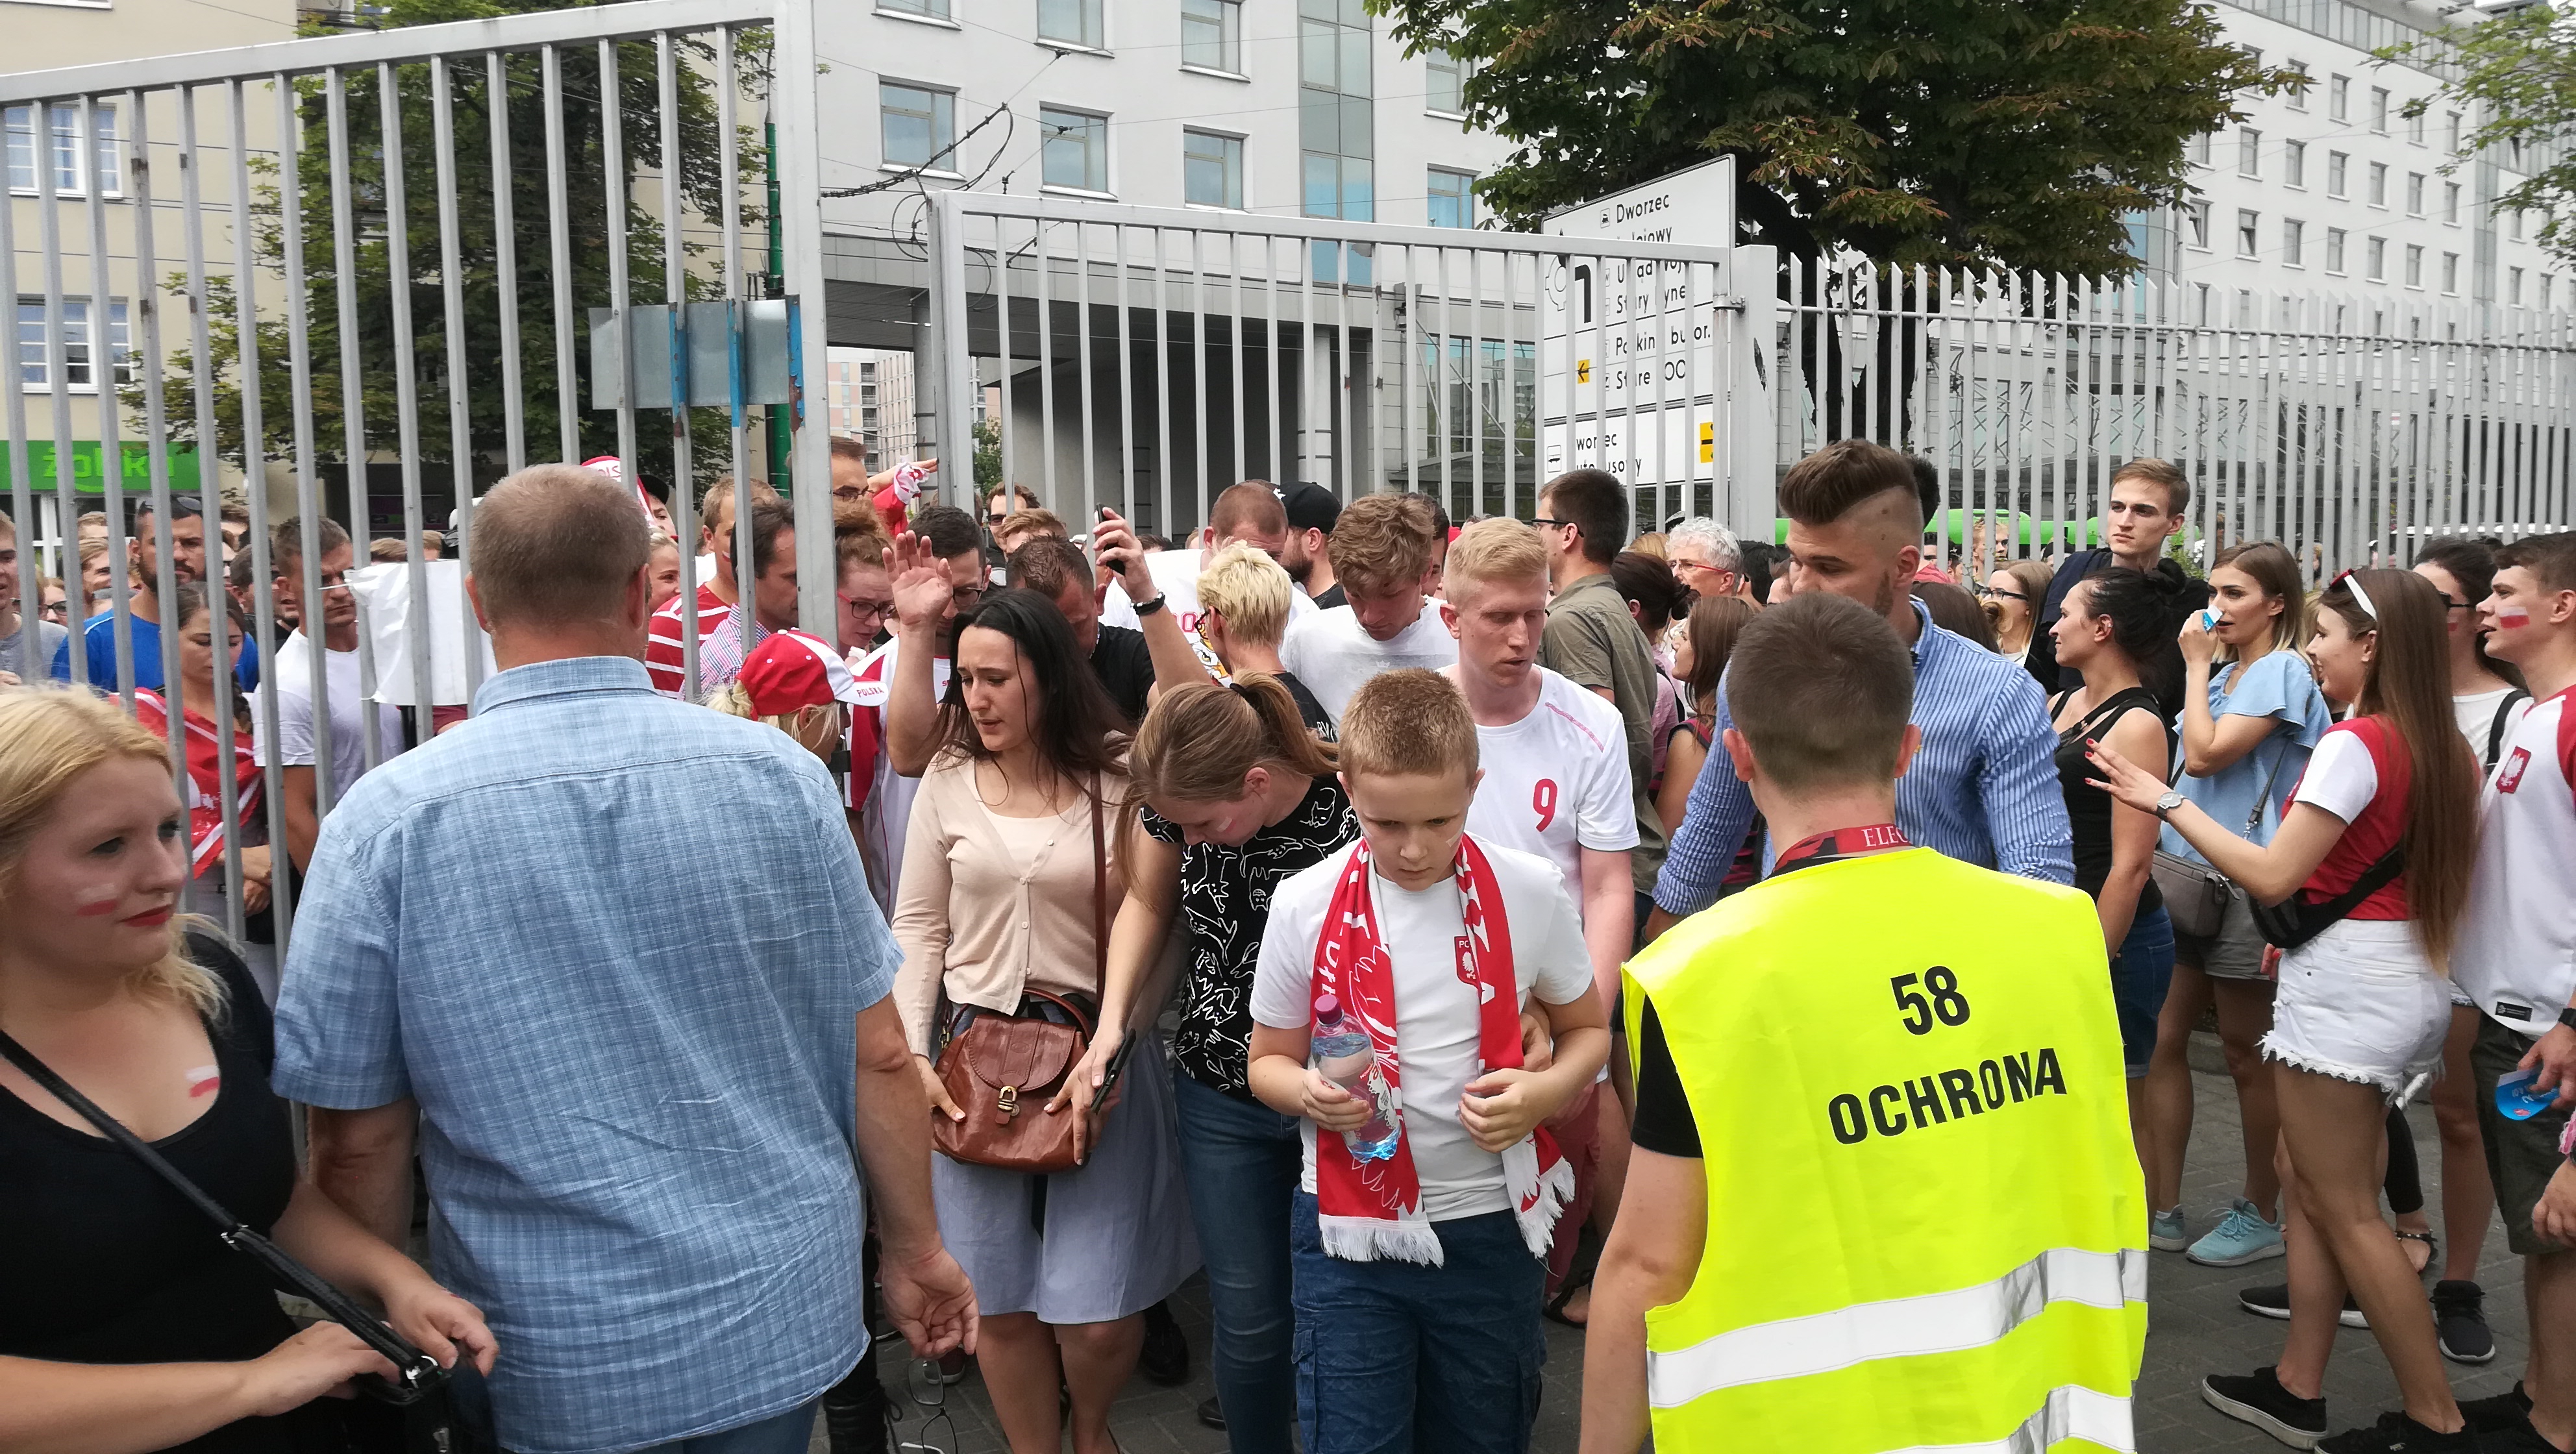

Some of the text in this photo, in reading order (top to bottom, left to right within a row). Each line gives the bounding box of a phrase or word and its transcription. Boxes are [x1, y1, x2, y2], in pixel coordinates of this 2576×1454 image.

[1616, 194, 1670, 223] Dworzec
[1671, 325, 1711, 345] buor.
[1576, 434, 1617, 450] worec
[856, 686, 886, 698] POLSKA
[1532, 778, 1558, 833] 9
[1890, 965, 1970, 1035] 58
[1828, 1048, 2068, 1144] OCHRONA
